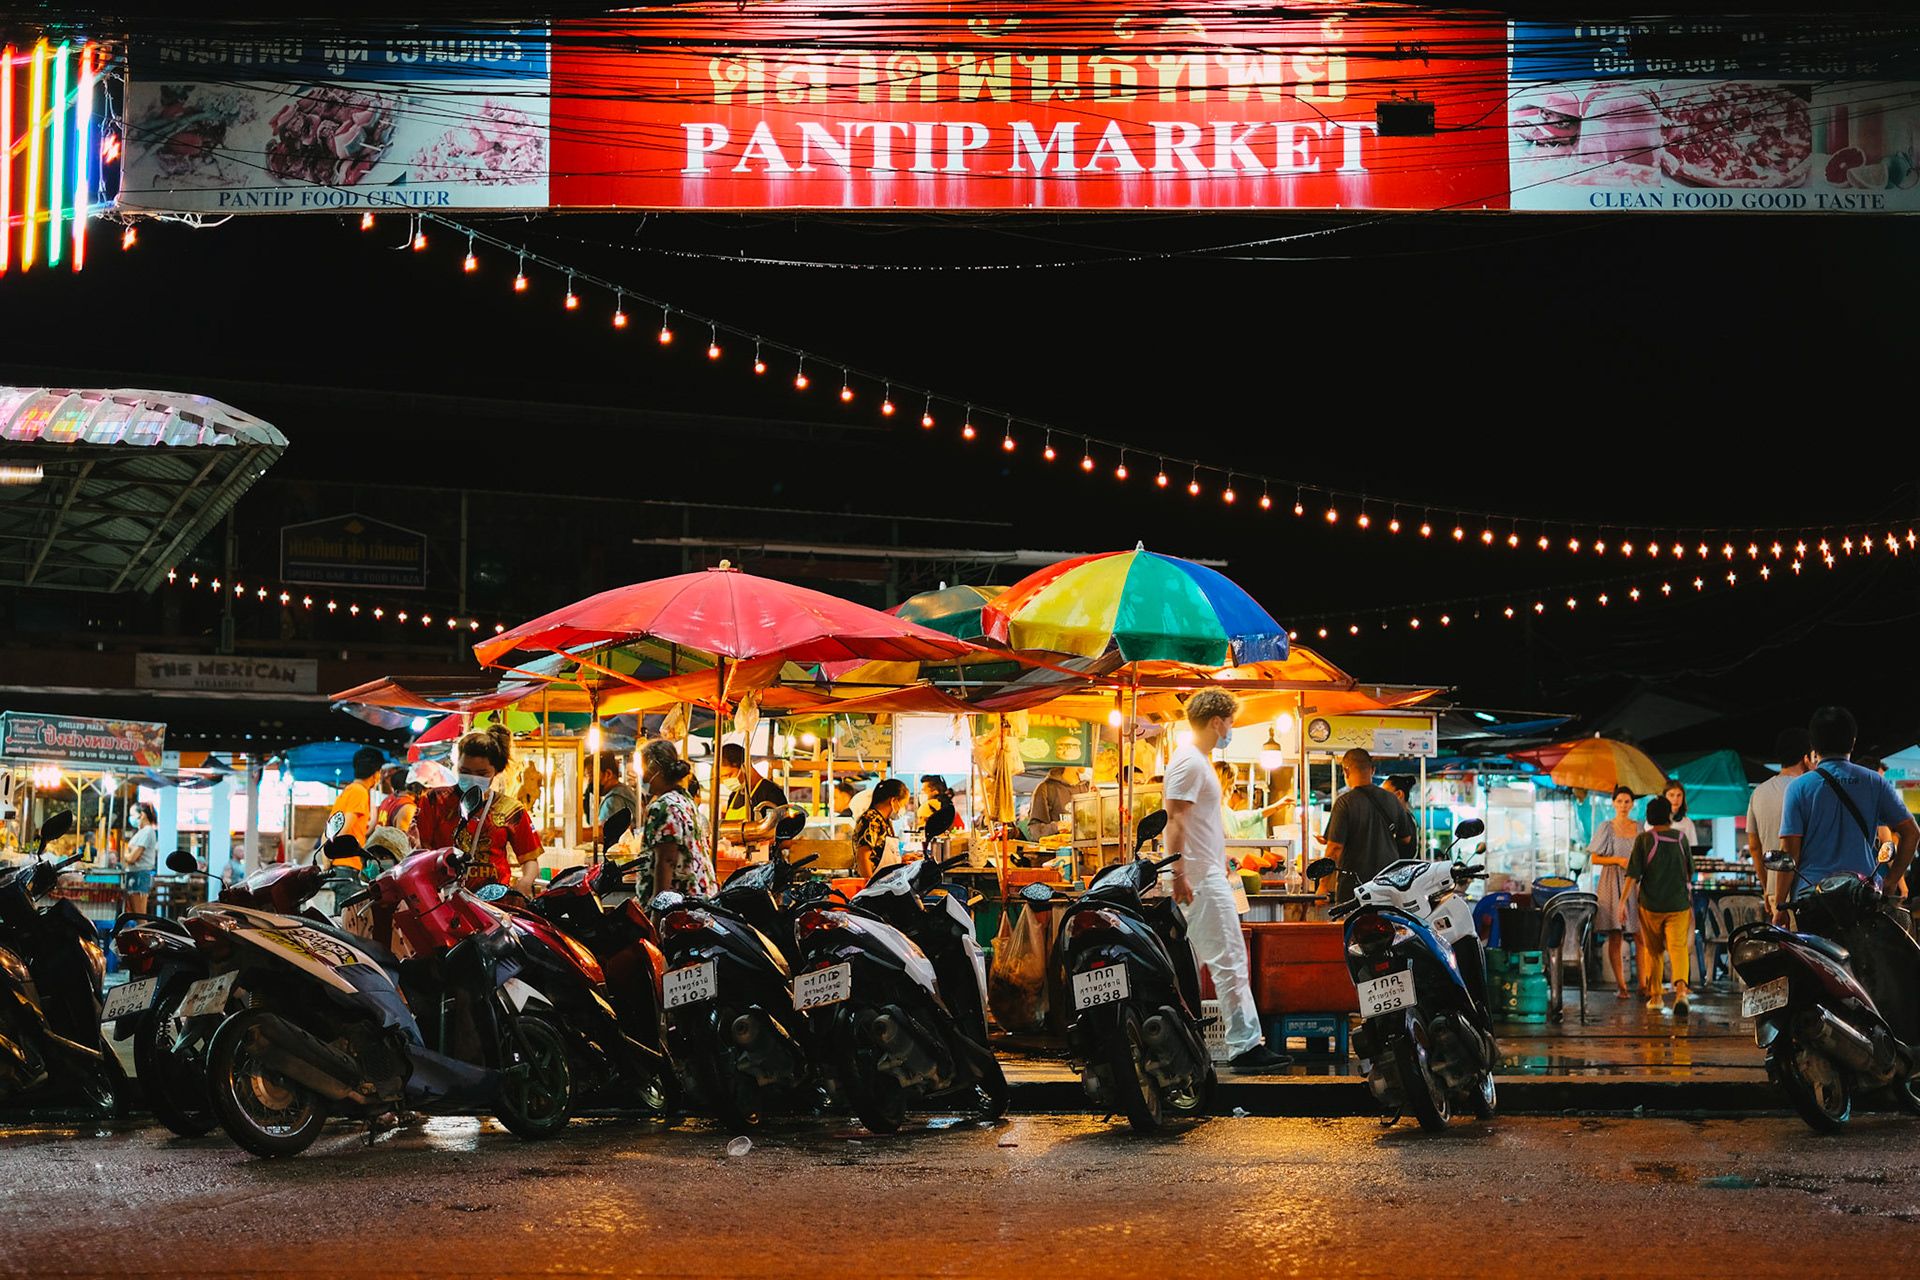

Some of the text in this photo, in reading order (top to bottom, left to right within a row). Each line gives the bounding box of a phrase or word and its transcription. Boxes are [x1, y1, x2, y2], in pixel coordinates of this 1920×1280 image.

[682, 121, 1380, 174] PANTIP MARKET
[219, 190, 451, 208] PANTIP FOOD CENTER
[1589, 192, 1886, 210] CLEAN FOOD GOOD TASTE
[148, 659, 297, 684] THE MEXICAN
[58, 721, 105, 732] GRILLED MALA
[1082, 989, 1121, 1006] 9838
[1373, 997, 1403, 1013] 953
[108, 1001, 144, 1018] 8624
